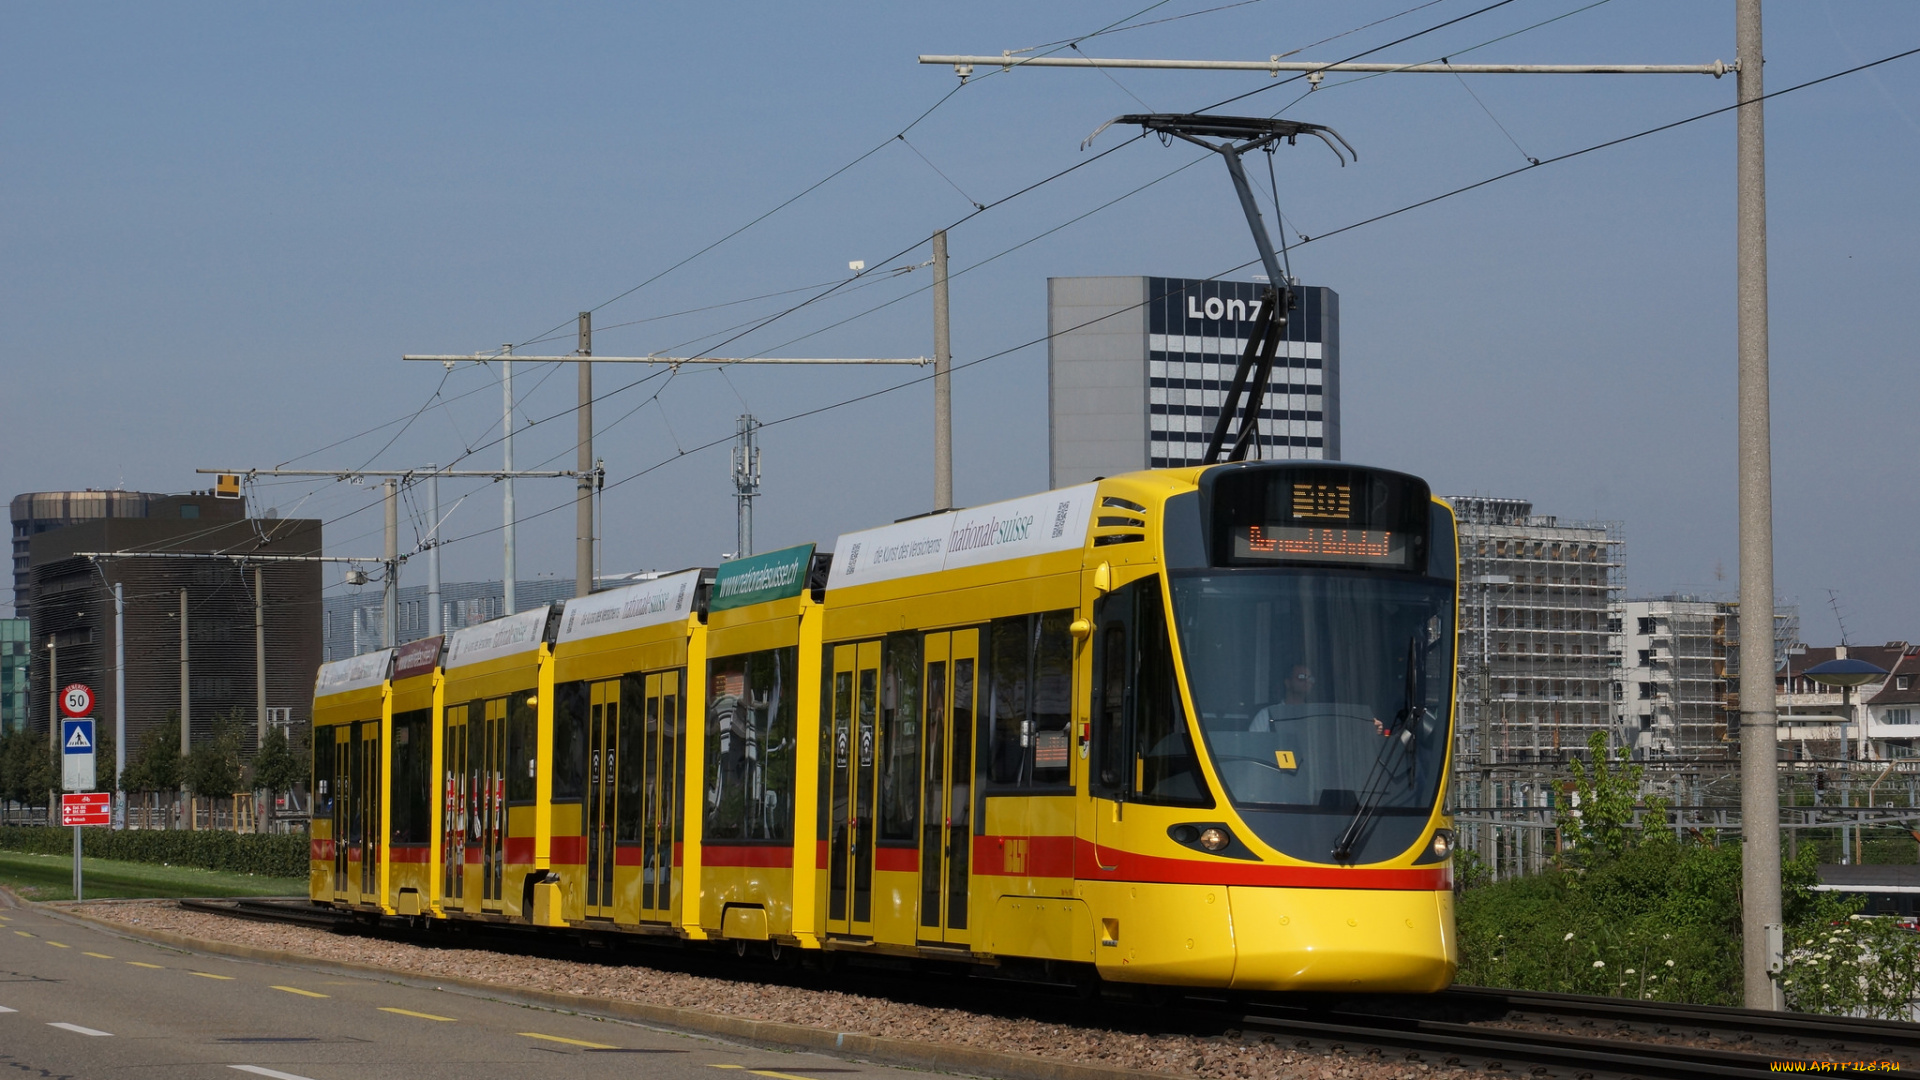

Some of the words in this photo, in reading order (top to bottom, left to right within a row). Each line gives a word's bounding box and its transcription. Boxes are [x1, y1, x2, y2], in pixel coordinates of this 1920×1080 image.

[1188, 296, 1274, 322] Lonz
[948, 511, 1034, 553] nationalesuisse
[881, 545, 899, 563] Kunst
[897, 540, 910, 560] des
[719, 556, 799, 598] www.nationalesuisse.ch
[69, 694, 85, 707] 50
[1283, 753, 1288, 763] 1
[1003, 839, 1027, 873] BLT
